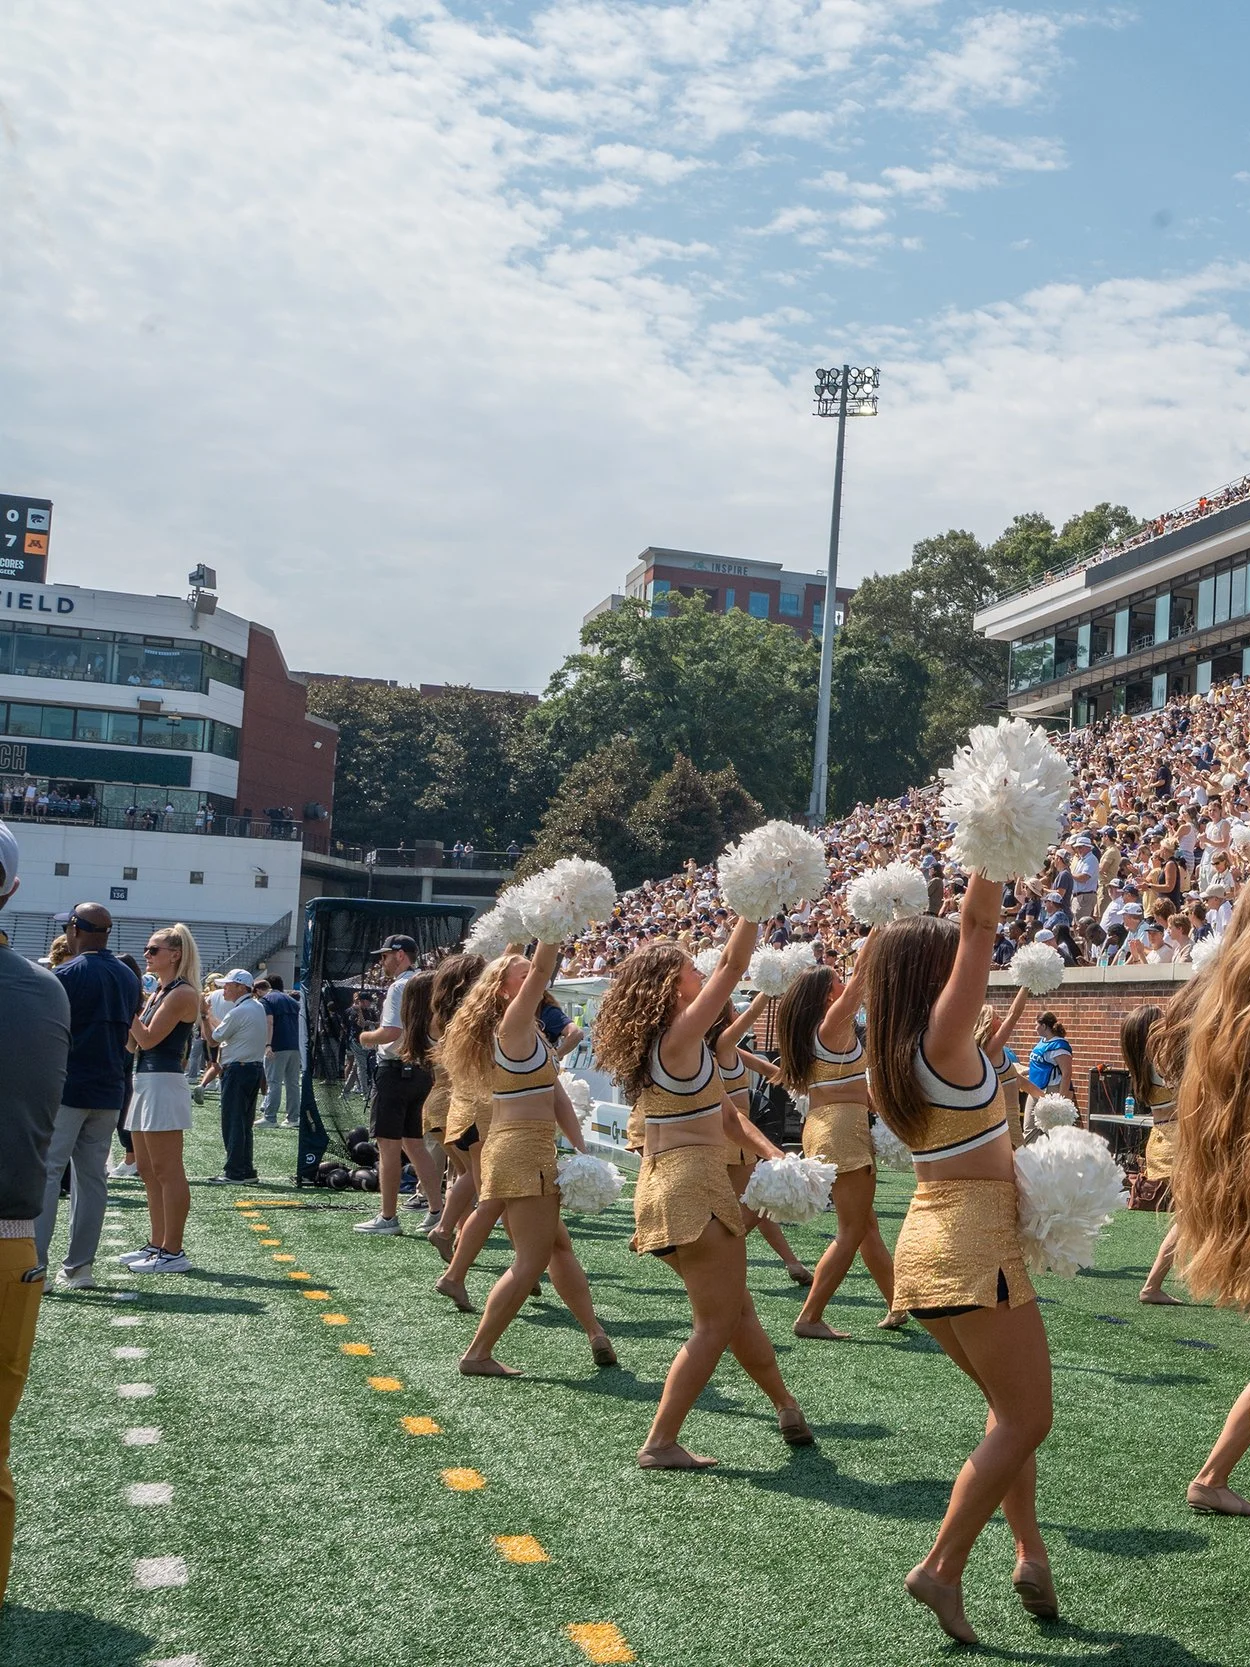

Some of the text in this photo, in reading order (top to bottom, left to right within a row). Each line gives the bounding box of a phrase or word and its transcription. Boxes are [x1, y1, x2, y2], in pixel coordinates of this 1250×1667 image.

[6, 509, 19, 523] 0
[5, 533, 17, 547] 7
[711, 562, 749, 576] INSPIRE
[0, 591, 74, 614] IELD
